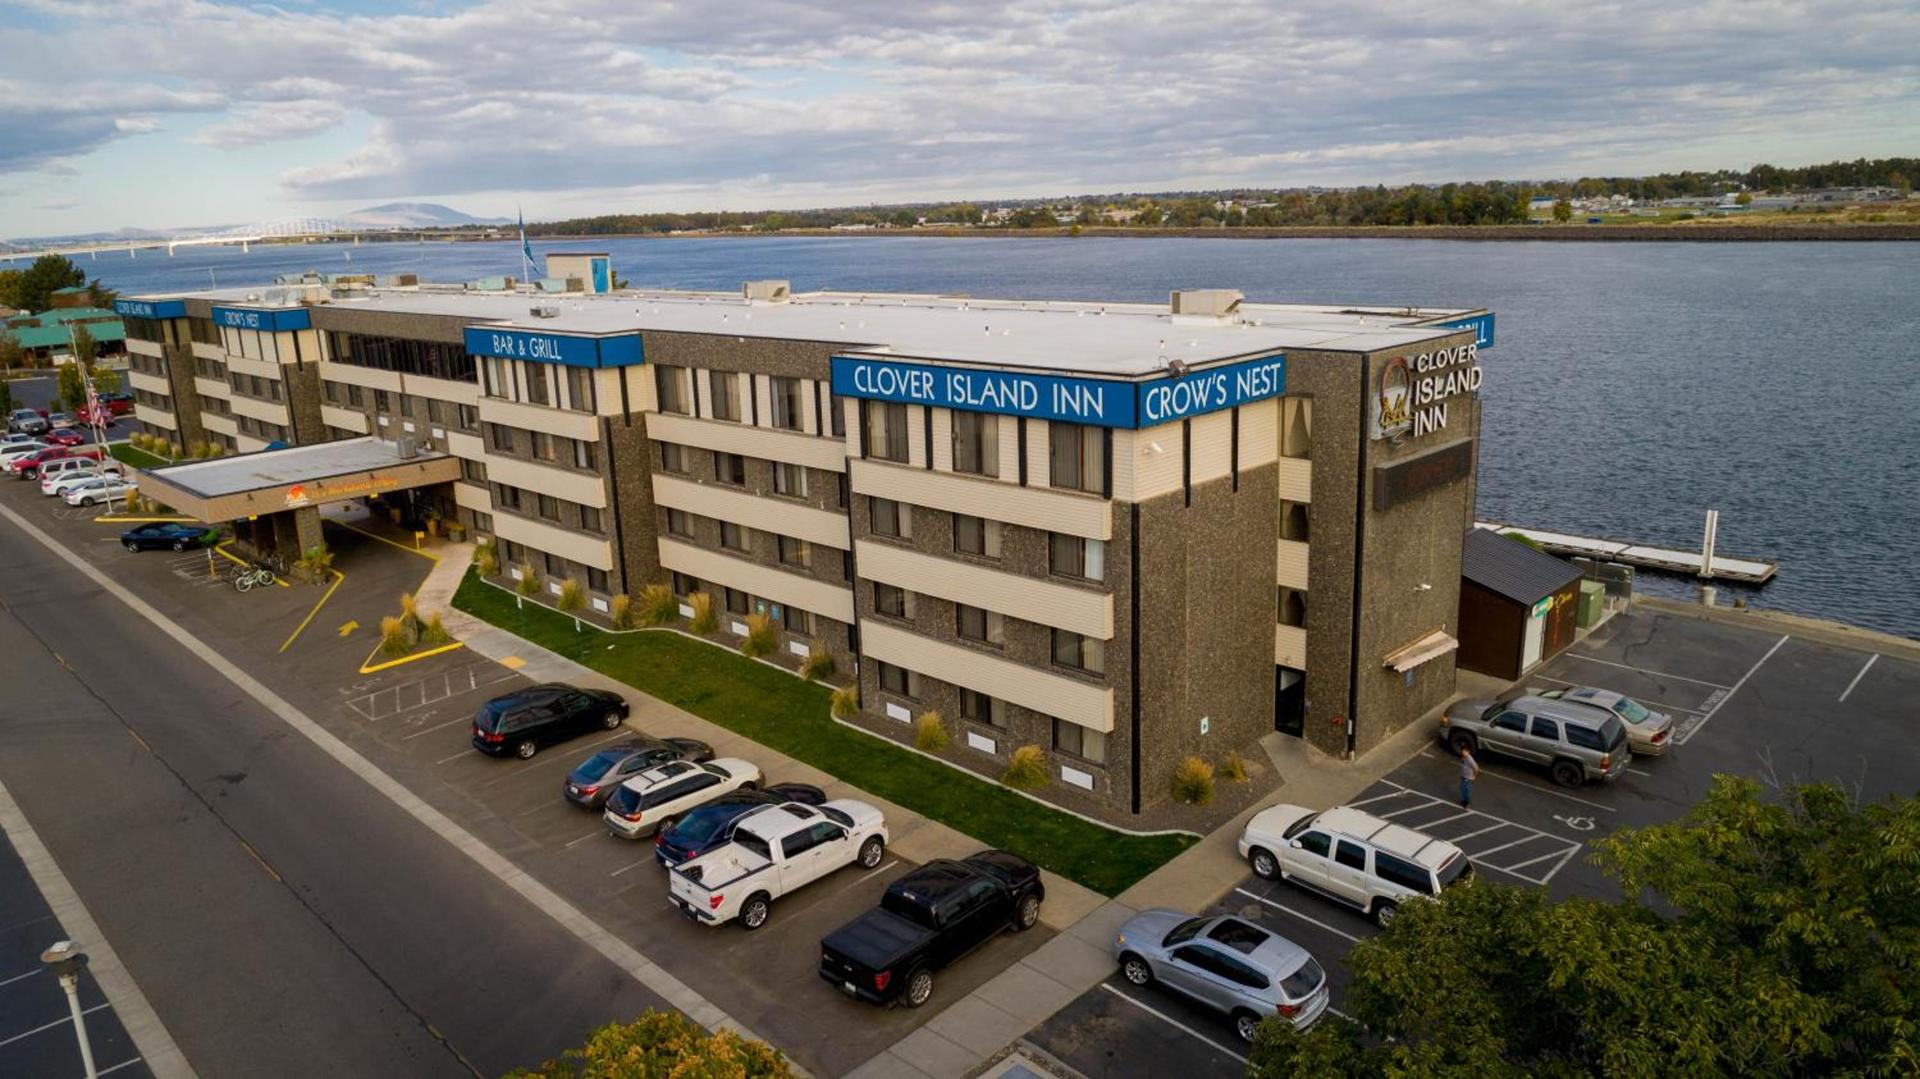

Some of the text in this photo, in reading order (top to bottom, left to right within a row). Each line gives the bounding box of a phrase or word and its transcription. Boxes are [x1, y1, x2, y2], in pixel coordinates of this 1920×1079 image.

[492, 334, 562, 360] BAR & GRILL
[1417, 343, 1477, 373] CLOVER
[854, 364, 1103, 418] CLOVER ISLAND INN
[1145, 362, 1281, 420] CROW'S NEST
[1414, 366, 1482, 406] ISLAND
[1413, 403, 1447, 438] INN
